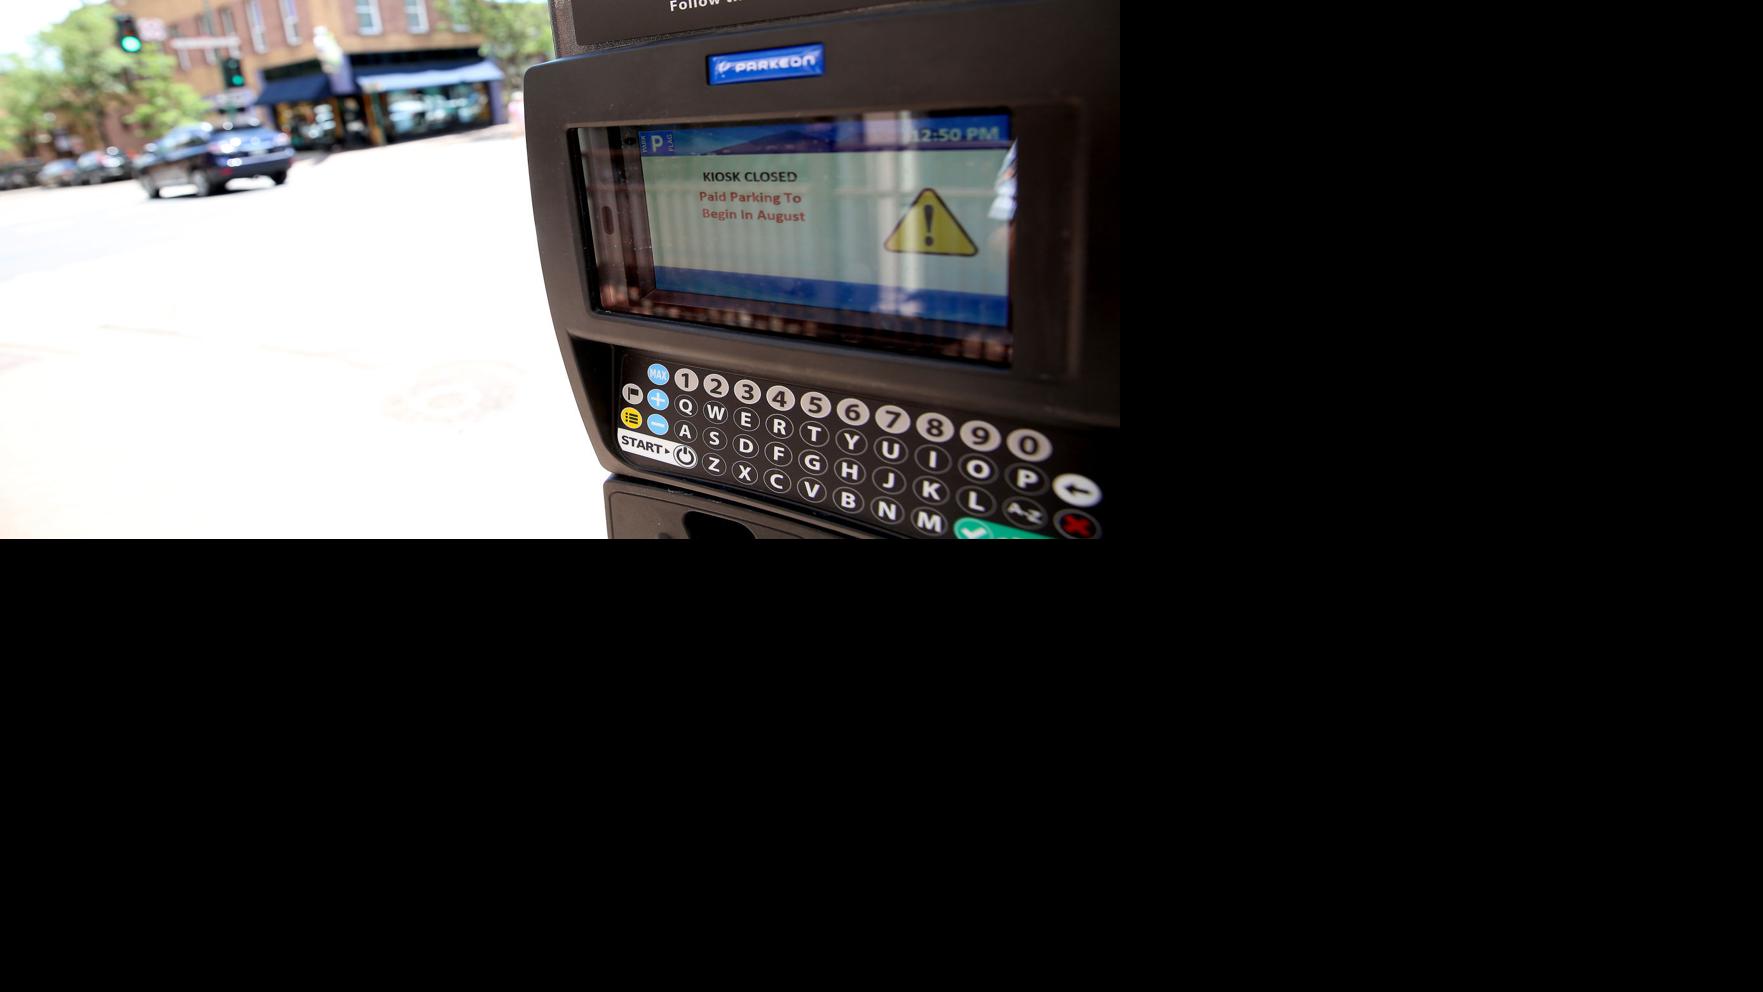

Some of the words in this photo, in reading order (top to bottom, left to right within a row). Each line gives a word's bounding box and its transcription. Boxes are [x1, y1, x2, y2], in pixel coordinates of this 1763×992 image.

[670, 0, 720, 12] Follow
[911, 127, 962, 142] 12:50
[966, 125, 1000, 141] PM
[650, 135, 663, 153] P
[703, 171, 741, 182] KIOSK
[744, 171, 798, 182] CLOSED
[699, 191, 726, 202] Paid
[730, 191, 781, 206] Parking
[783, 192, 803, 204] To
[702, 208, 737, 221] Begin
[741, 209, 753, 220] In
[757, 210, 806, 224] August
[649, 368, 668, 381] MAX
[681, 373, 689, 388] 1
[710, 378, 722, 395] 2
[742, 384, 754, 401] 3
[772, 391, 787, 407] 4
[808, 397, 822, 414] 5
[845, 404, 860, 421] 6
[885, 410, 901, 428] 7
[926, 419, 943, 437] 8
[971, 427, 990, 445] 9
[1019, 436, 1038, 455] 0
[621, 435, 663, 454] START
[679, 399, 693, 415] Q
[707, 404, 724, 421] W
[740, 411, 751, 427] E
[773, 419, 786, 435] R
[807, 425, 821, 442] T
[844, 433, 860, 450] Y
[882, 441, 900, 459] U
[1016, 469, 1039, 488] P
[679, 424, 692, 439] A
[709, 431, 720, 446] S
[739, 439, 754, 454] D
[773, 446, 784, 461] F
[804, 454, 821, 471] G
[841, 462, 859, 480] H
[883, 473, 895, 488] J
[922, 480, 941, 500] K
[968, 491, 985, 512] L
[708, 457, 720, 472] Z
[738, 465, 751, 481] X
[770, 473, 784, 489] C
[804, 481, 820, 498] V
[841, 492, 856, 509] B
[878, 500, 897, 520] N
[917, 511, 942, 533] M
